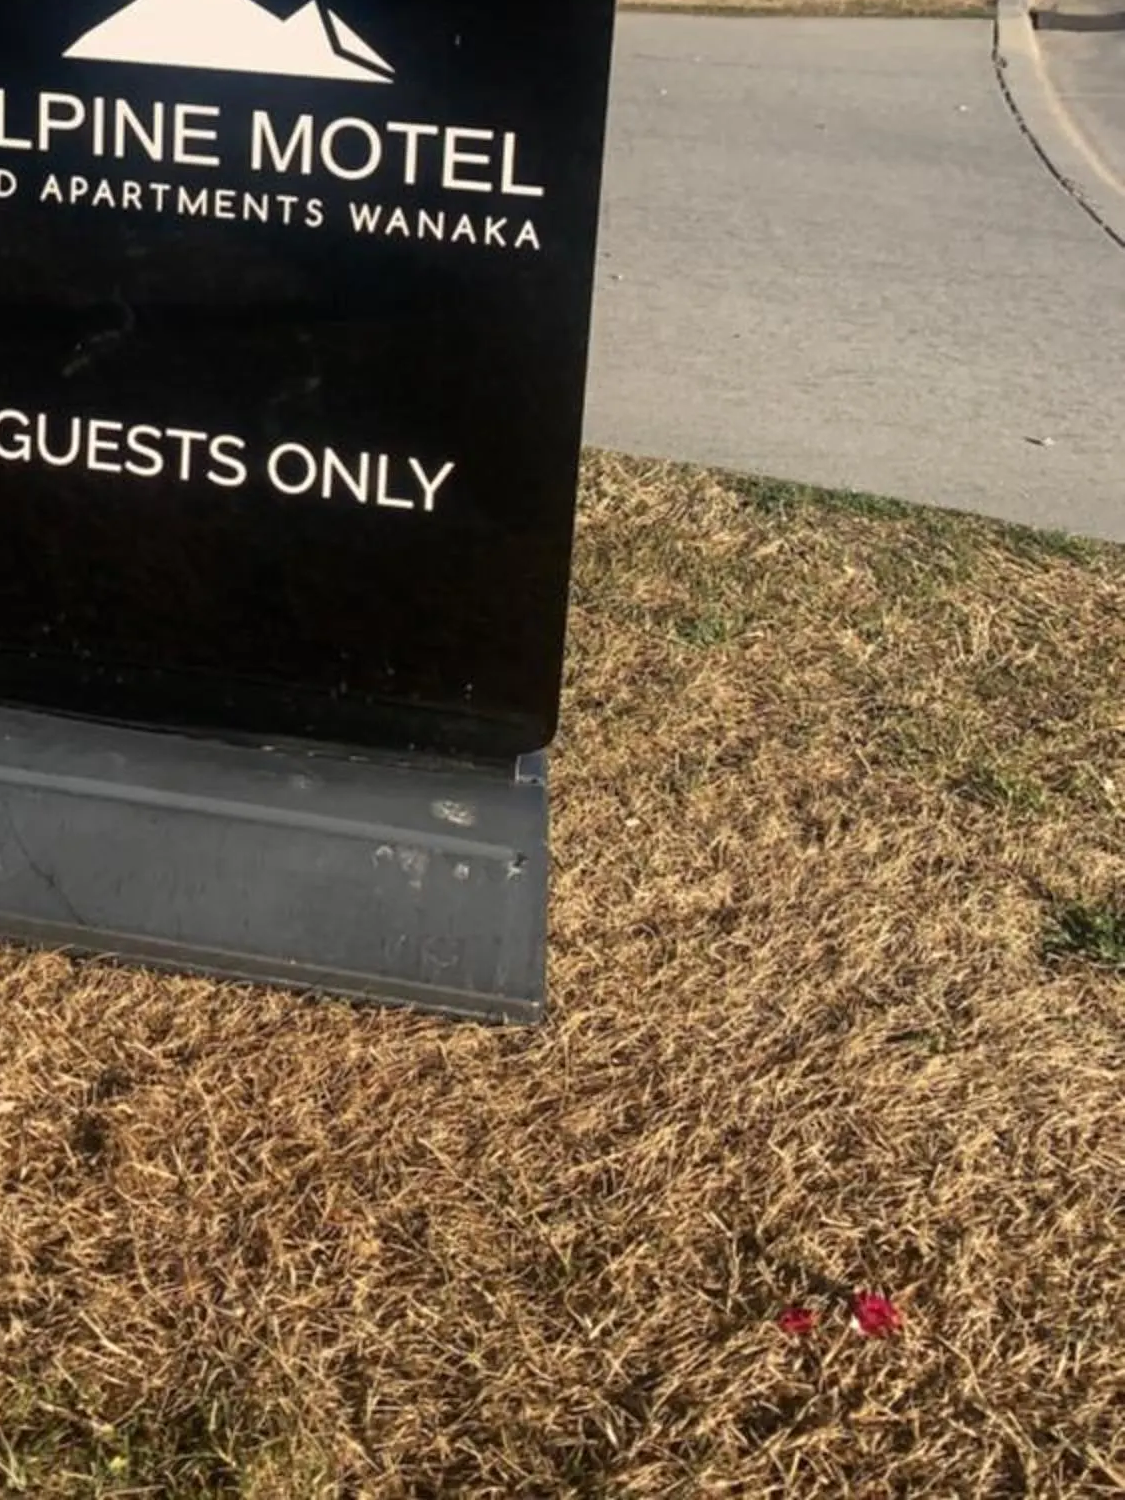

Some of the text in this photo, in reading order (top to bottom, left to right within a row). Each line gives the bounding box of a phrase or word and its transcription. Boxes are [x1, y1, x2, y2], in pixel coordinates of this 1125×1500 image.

[249, 108, 545, 198] MOTEL
[39, 173, 325, 229] APARTMENTS
[348, 201, 541, 251] WANAKA
[266, 441, 456, 513] ONLY
